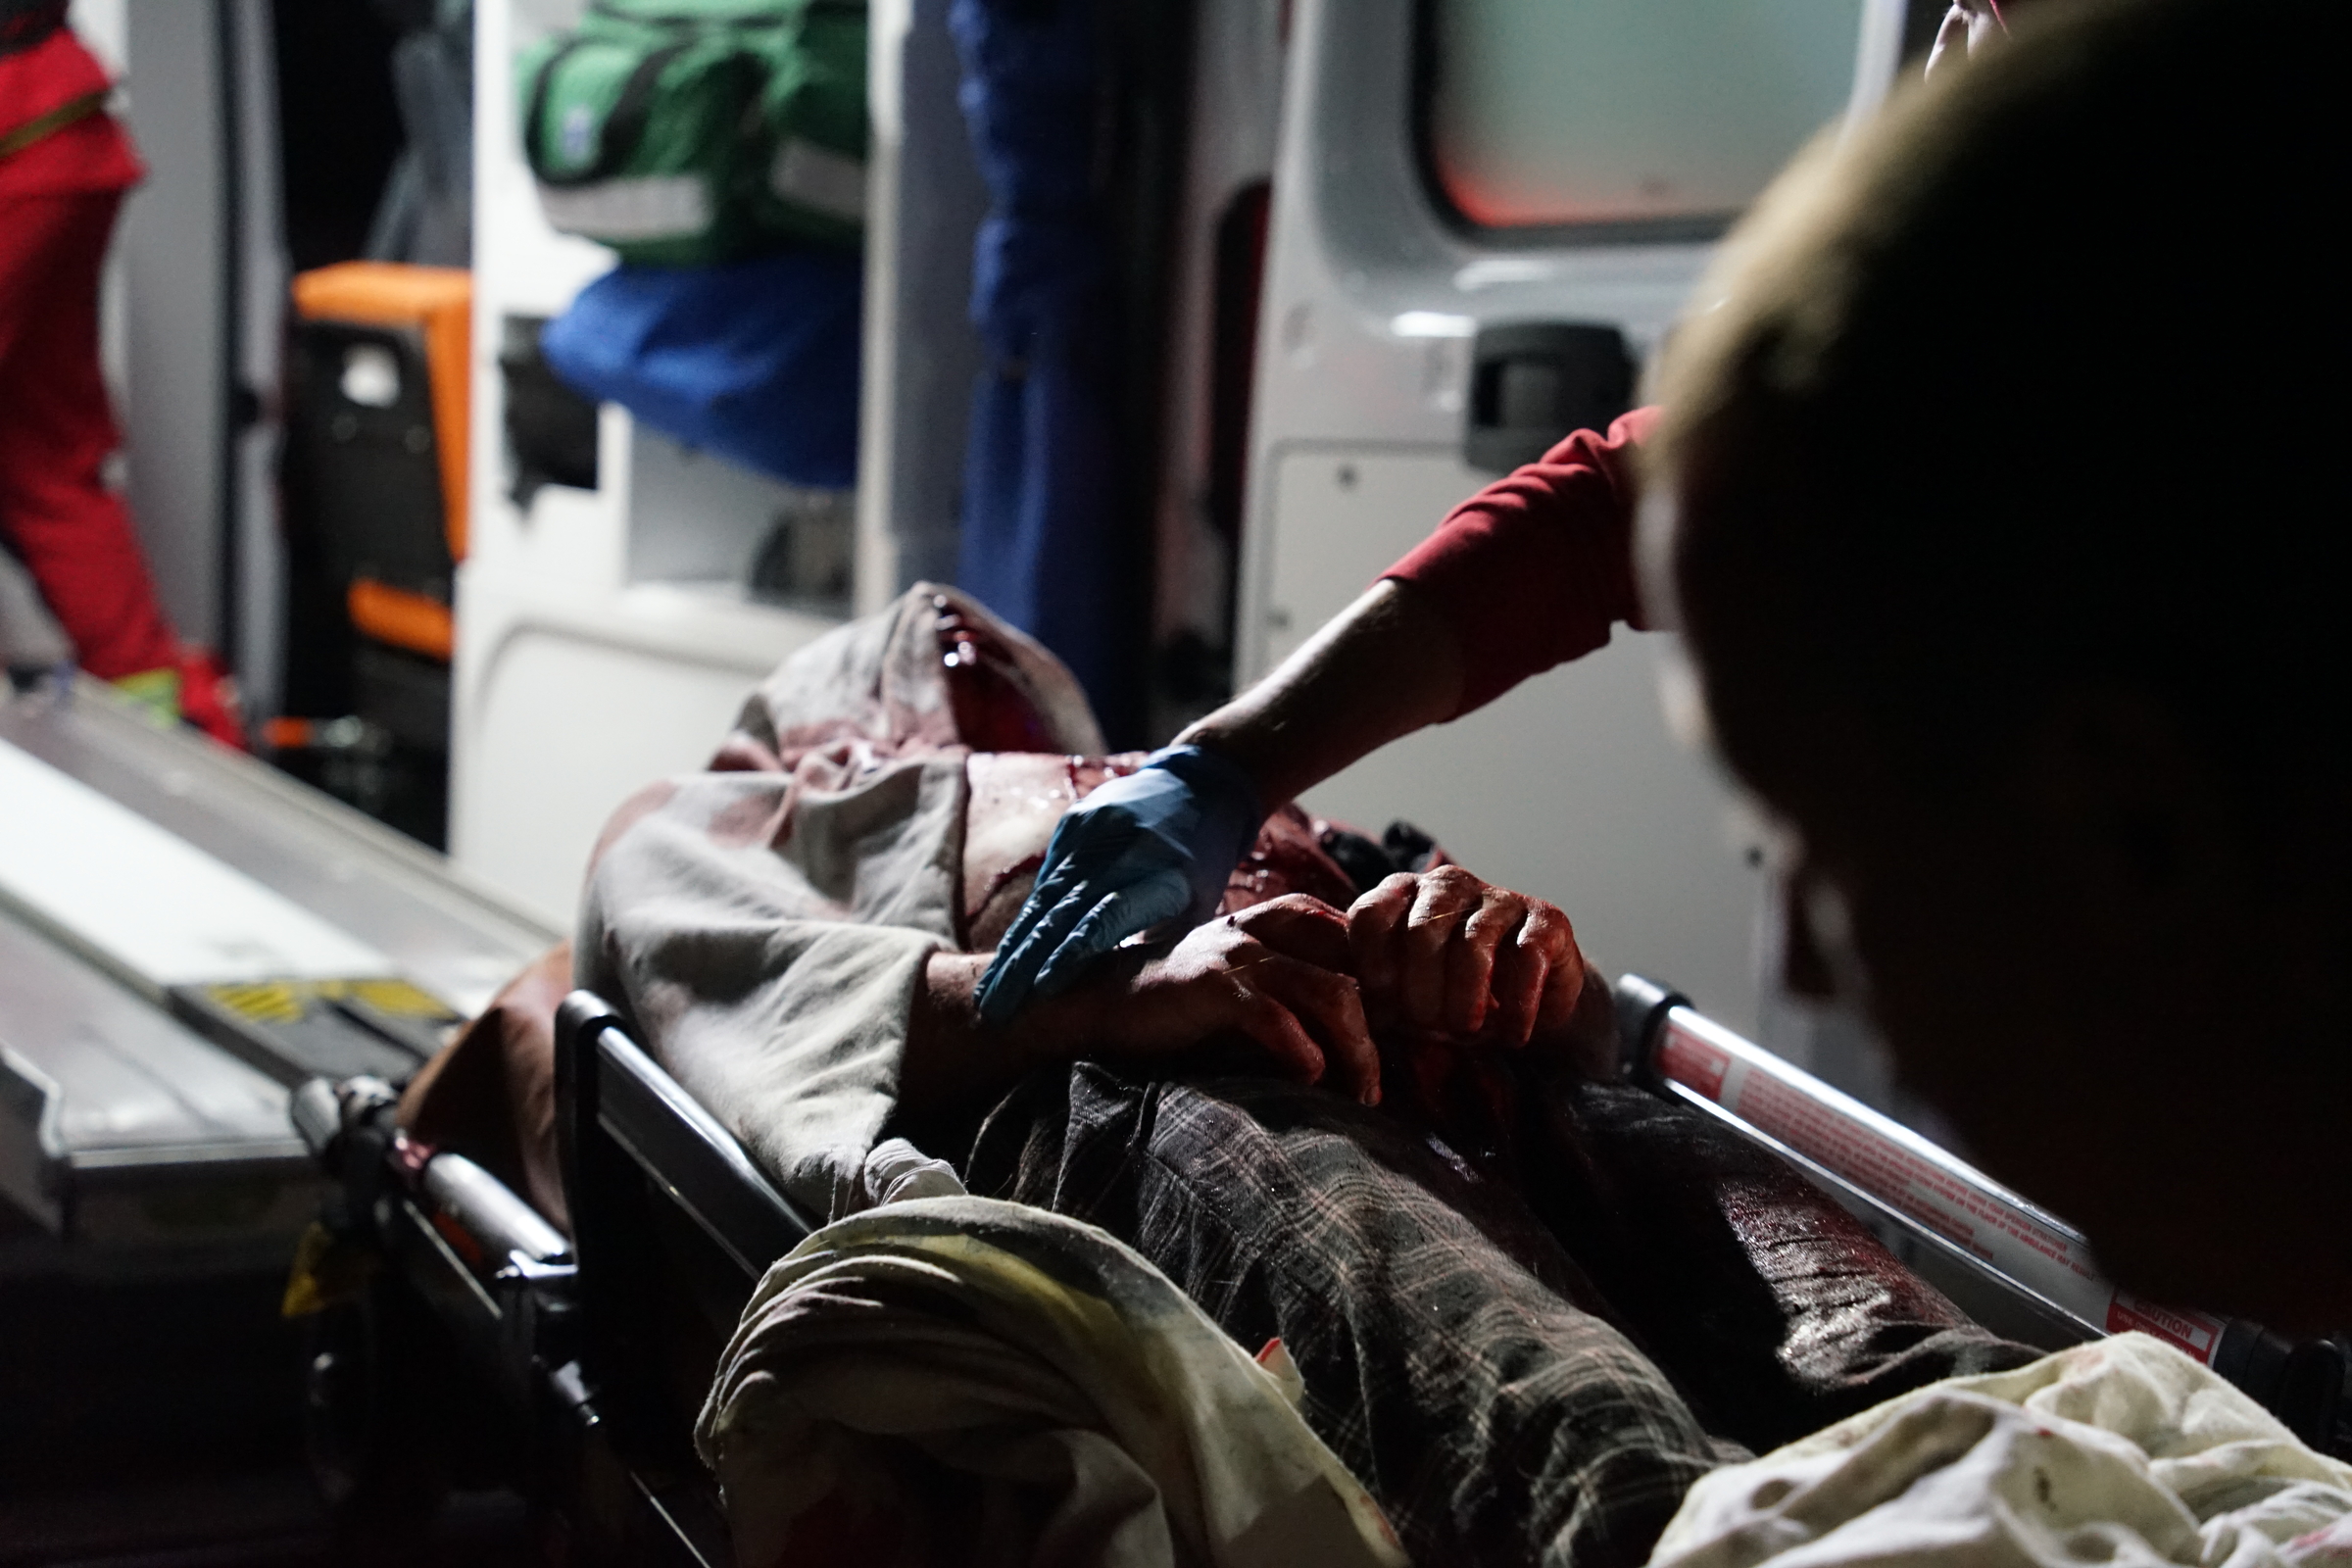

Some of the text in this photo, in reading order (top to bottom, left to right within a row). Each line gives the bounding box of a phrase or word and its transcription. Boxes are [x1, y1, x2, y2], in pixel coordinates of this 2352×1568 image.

[2019, 1233, 2056, 1259] AMBULANCE
[2056, 1253, 2071, 1266] MAY
[2117, 1311, 2133, 1326] USE
[2135, 1301, 2192, 1339] CAUTION
